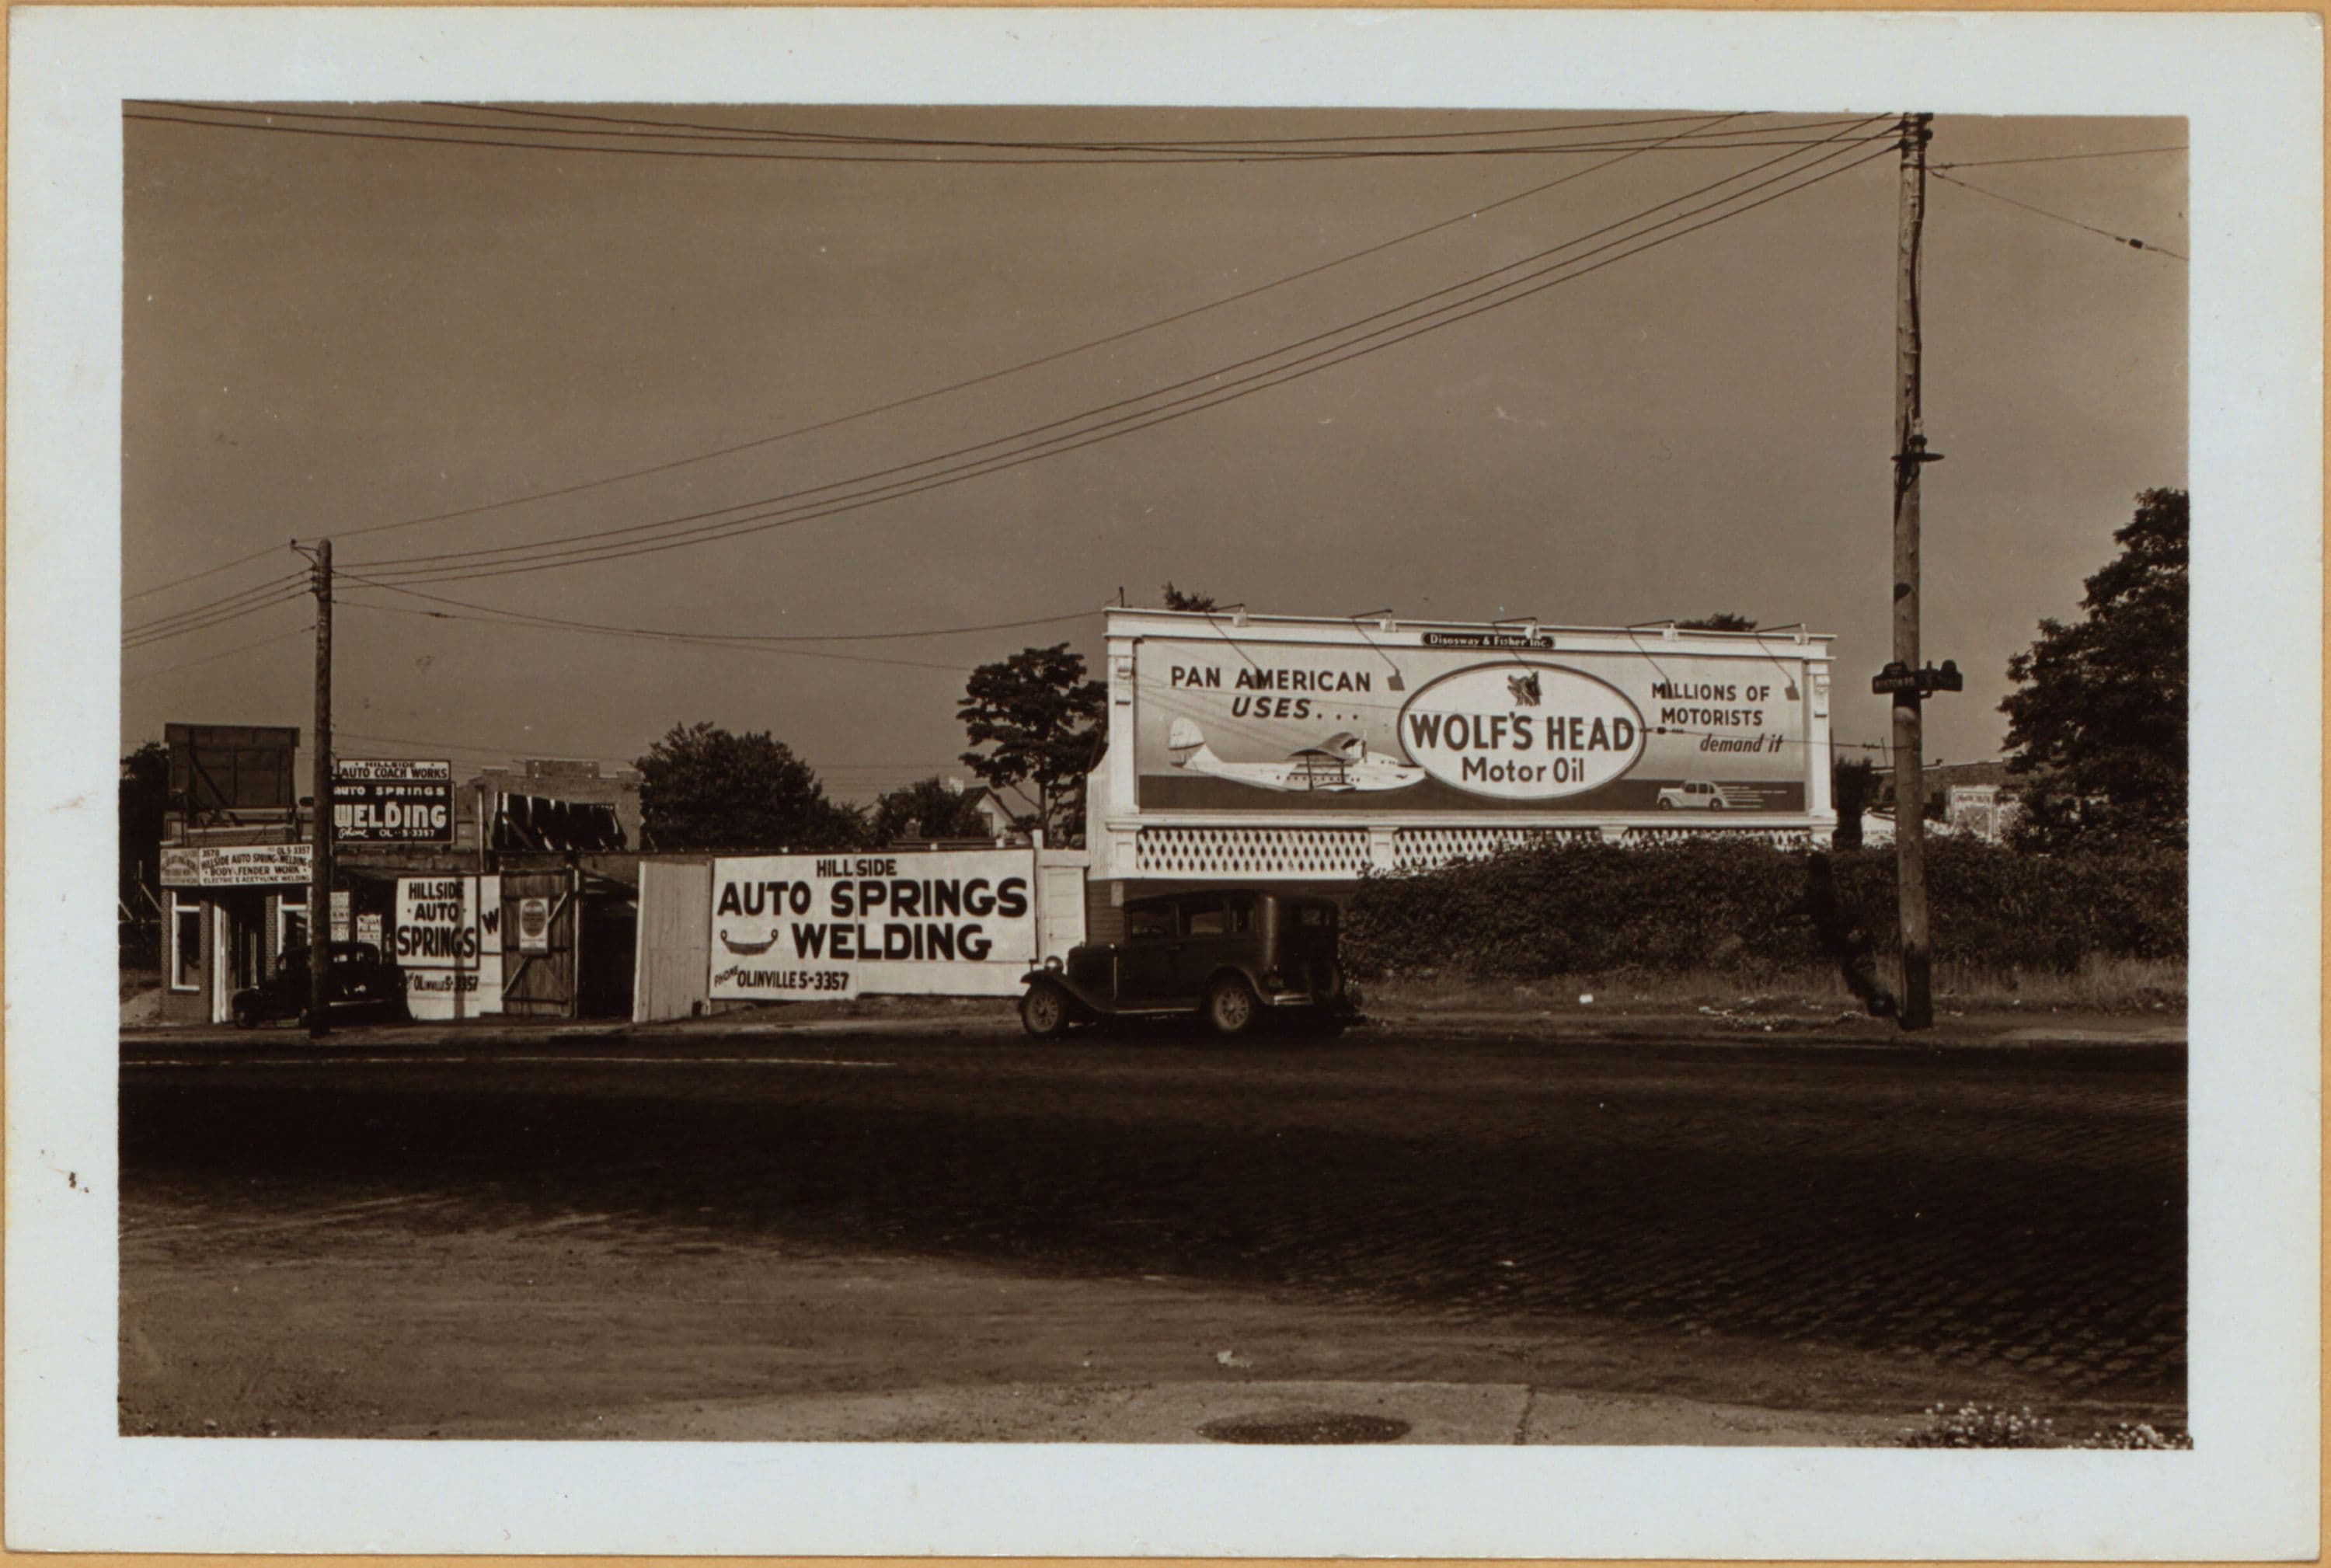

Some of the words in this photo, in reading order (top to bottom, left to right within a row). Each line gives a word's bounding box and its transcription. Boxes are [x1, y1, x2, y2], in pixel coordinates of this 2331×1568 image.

[1483, 636, 1490, 646] &
[1493, 636, 1527, 646] Fisher
[1530, 637, 1551, 647] Inc.
[1171, 666, 1221, 688] PAN
[1235, 667, 1371, 692] AMERICAN
[1652, 682, 1737, 702] MILLIONS
[1746, 685, 1770, 702] OF
[1661, 707, 1764, 727] MOTORISTS
[1409, 711, 1534, 751] WOLF'S
[1546, 716, 1635, 751] HEAD
[1699, 733, 1765, 752] demand
[1768, 733, 1785, 752] it
[342, 768, 370, 779] AUTO
[375, 767, 407, 779] COACH
[411, 767, 448, 779] WORKS
[1462, 756, 1547, 782] Motor
[1553, 756, 1584, 783] Oil
[333, 786, 366, 796] AUTO
[201, 855, 229, 870] HILLSIDE
[232, 854, 251, 864] AUTO
[211, 867, 232, 876] BODY
[238, 866, 270, 876] FENDER
[274, 866, 300, 875] WORK
[817, 858, 897, 878] HILLSIDE
[409, 881, 464, 901] HILLSIDE
[717, 881, 811, 916] AUTO
[831, 878, 1028, 919] SPRINGS
[415, 903, 459, 922] AUTO
[397, 925, 476, 959] SPRINGS
[791, 923, 992, 962] WELDING
[713, 965, 738, 988] PHONE
[737, 968, 796, 991] OLINVILLE
[798, 970, 849, 991] 5-3357
